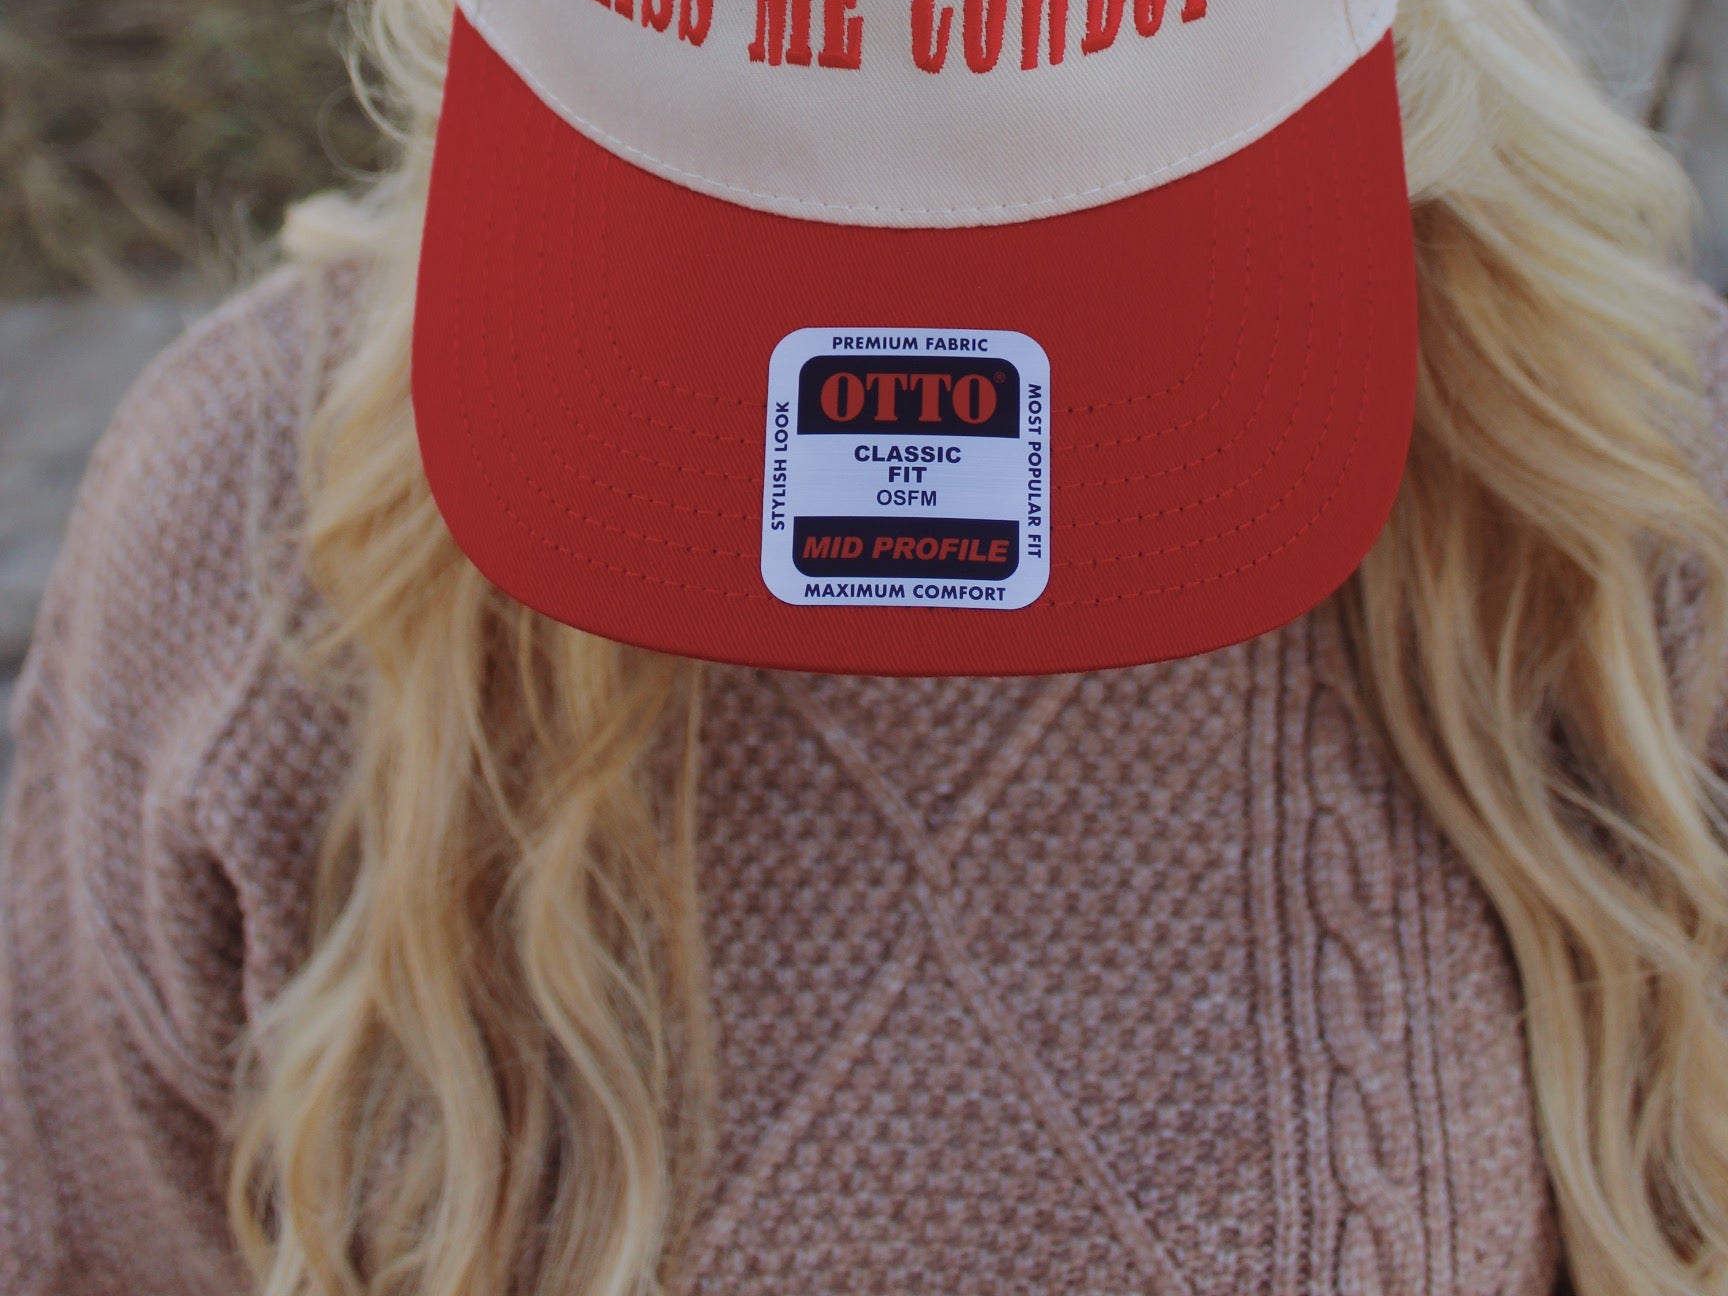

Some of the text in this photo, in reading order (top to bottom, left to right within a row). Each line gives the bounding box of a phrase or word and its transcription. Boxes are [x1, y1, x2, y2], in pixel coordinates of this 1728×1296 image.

[832, 336, 988, 352] PREMIUM FABRIC
[820, 371, 997, 425] OTTO
[854, 444, 962, 464] CLASSIC
[771, 401, 789, 531] STYLISH LOOK
[888, 466, 927, 483] FIT
[1027, 383, 1042, 558] MOST POPULAR FIT
[876, 489, 937, 507] OSFM
[803, 536, 1010, 563] MID PROFILE
[804, 583, 1006, 601] MAXIMUM COMFORT
